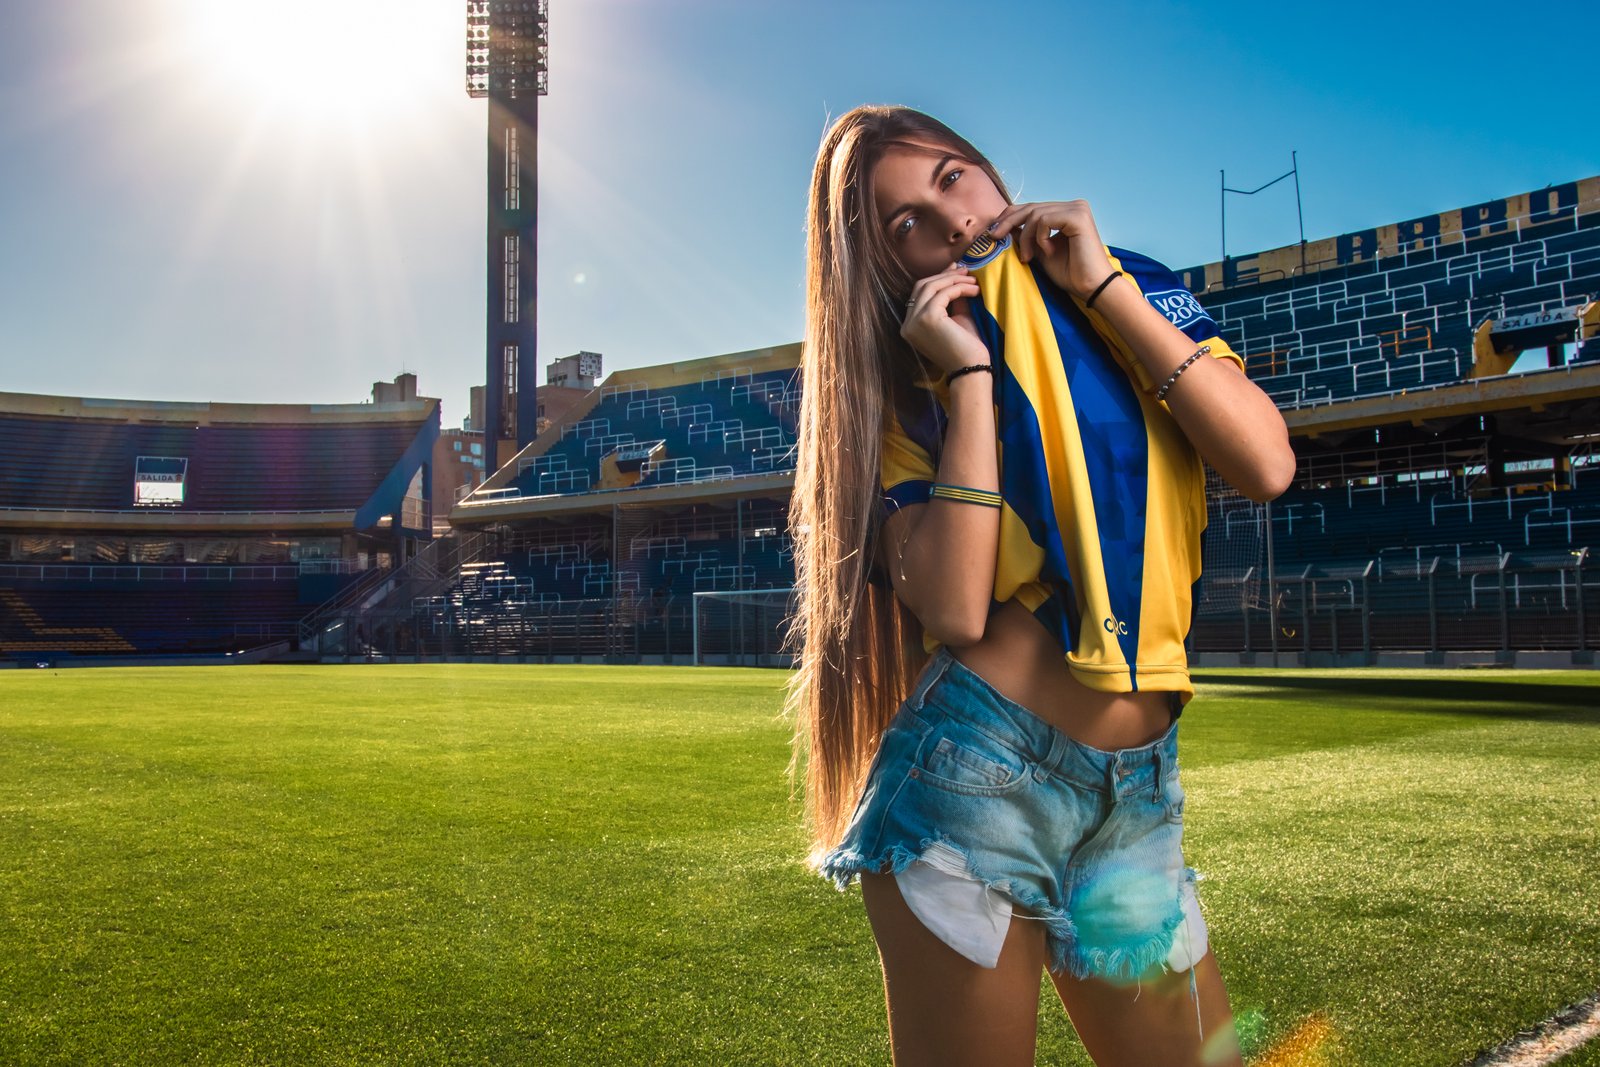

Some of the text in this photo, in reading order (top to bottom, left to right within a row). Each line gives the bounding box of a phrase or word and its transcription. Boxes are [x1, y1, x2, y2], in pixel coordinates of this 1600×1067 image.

[1154, 293, 1200, 312] VOS
[1166, 303, 1209, 325] 200
[1502, 312, 1563, 329] SALIDA
